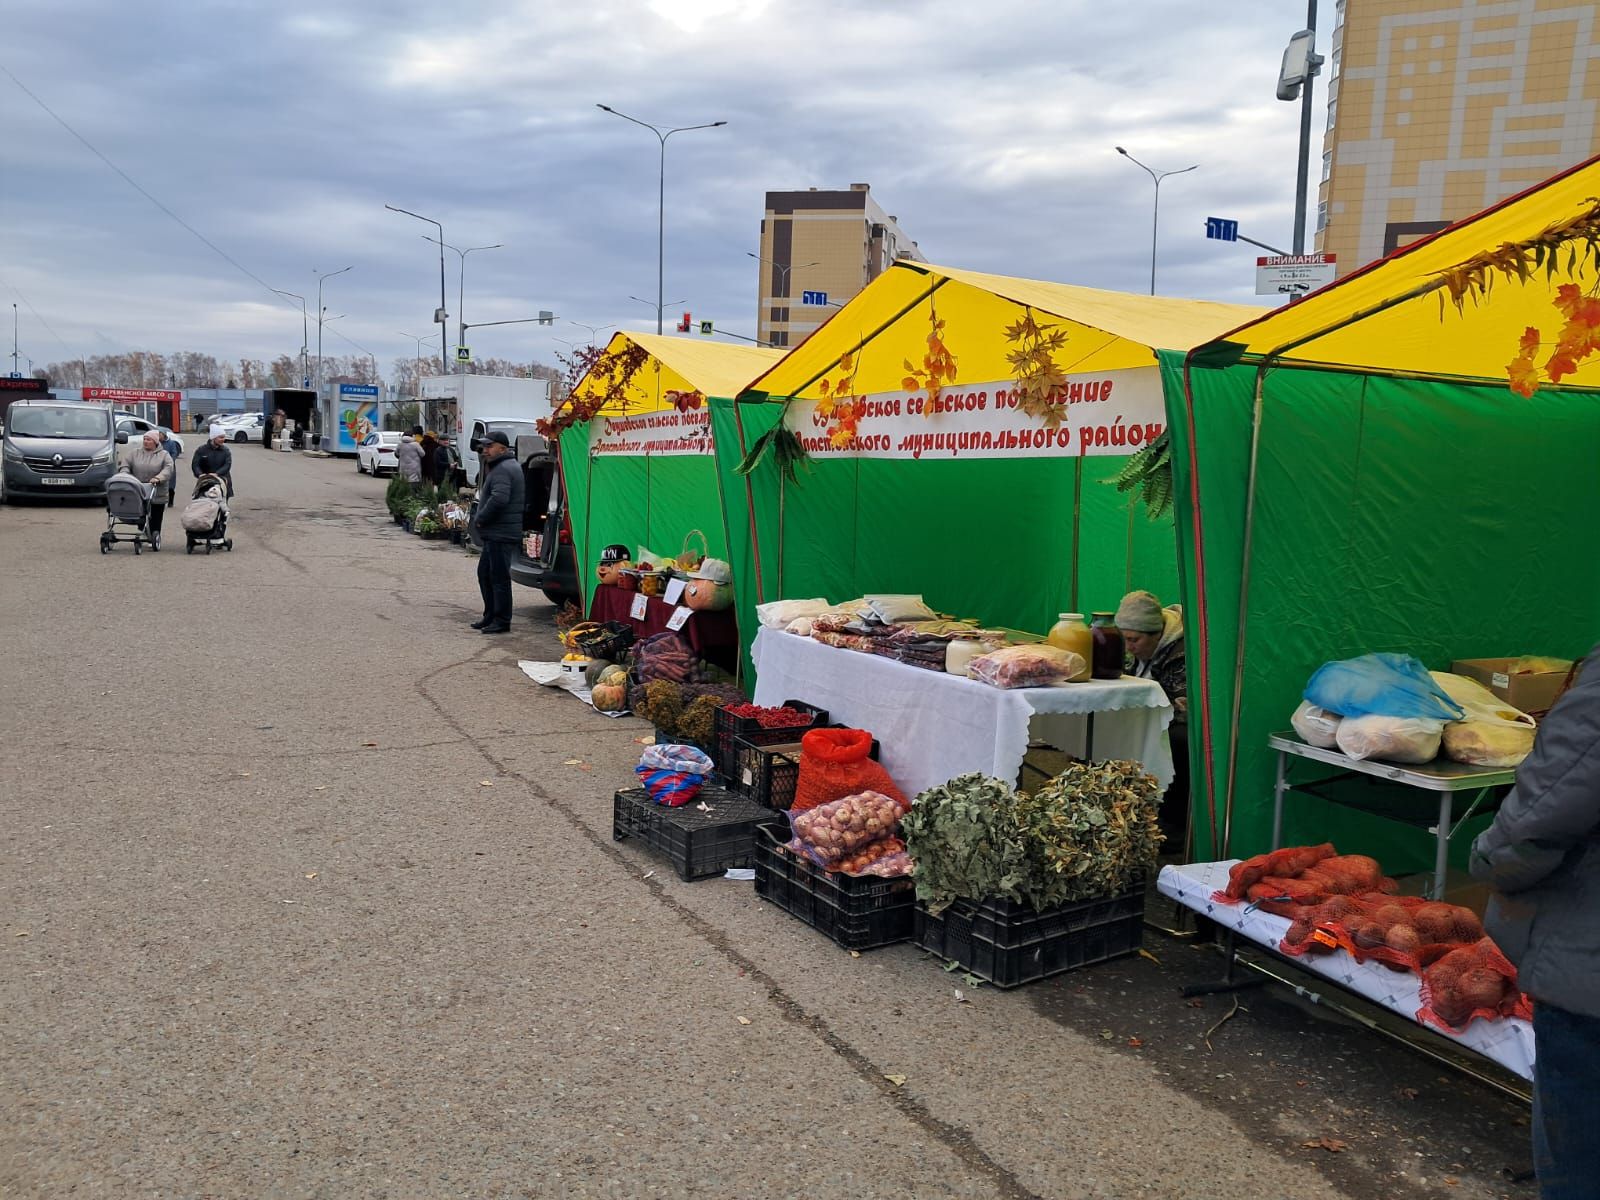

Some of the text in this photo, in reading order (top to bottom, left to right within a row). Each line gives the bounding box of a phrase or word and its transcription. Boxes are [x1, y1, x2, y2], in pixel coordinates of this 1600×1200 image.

[1266, 254, 1326, 265] ВНИМАНИЕ
[906, 391, 987, 414] сеьское
[897, 425, 1070, 460] муниципального
